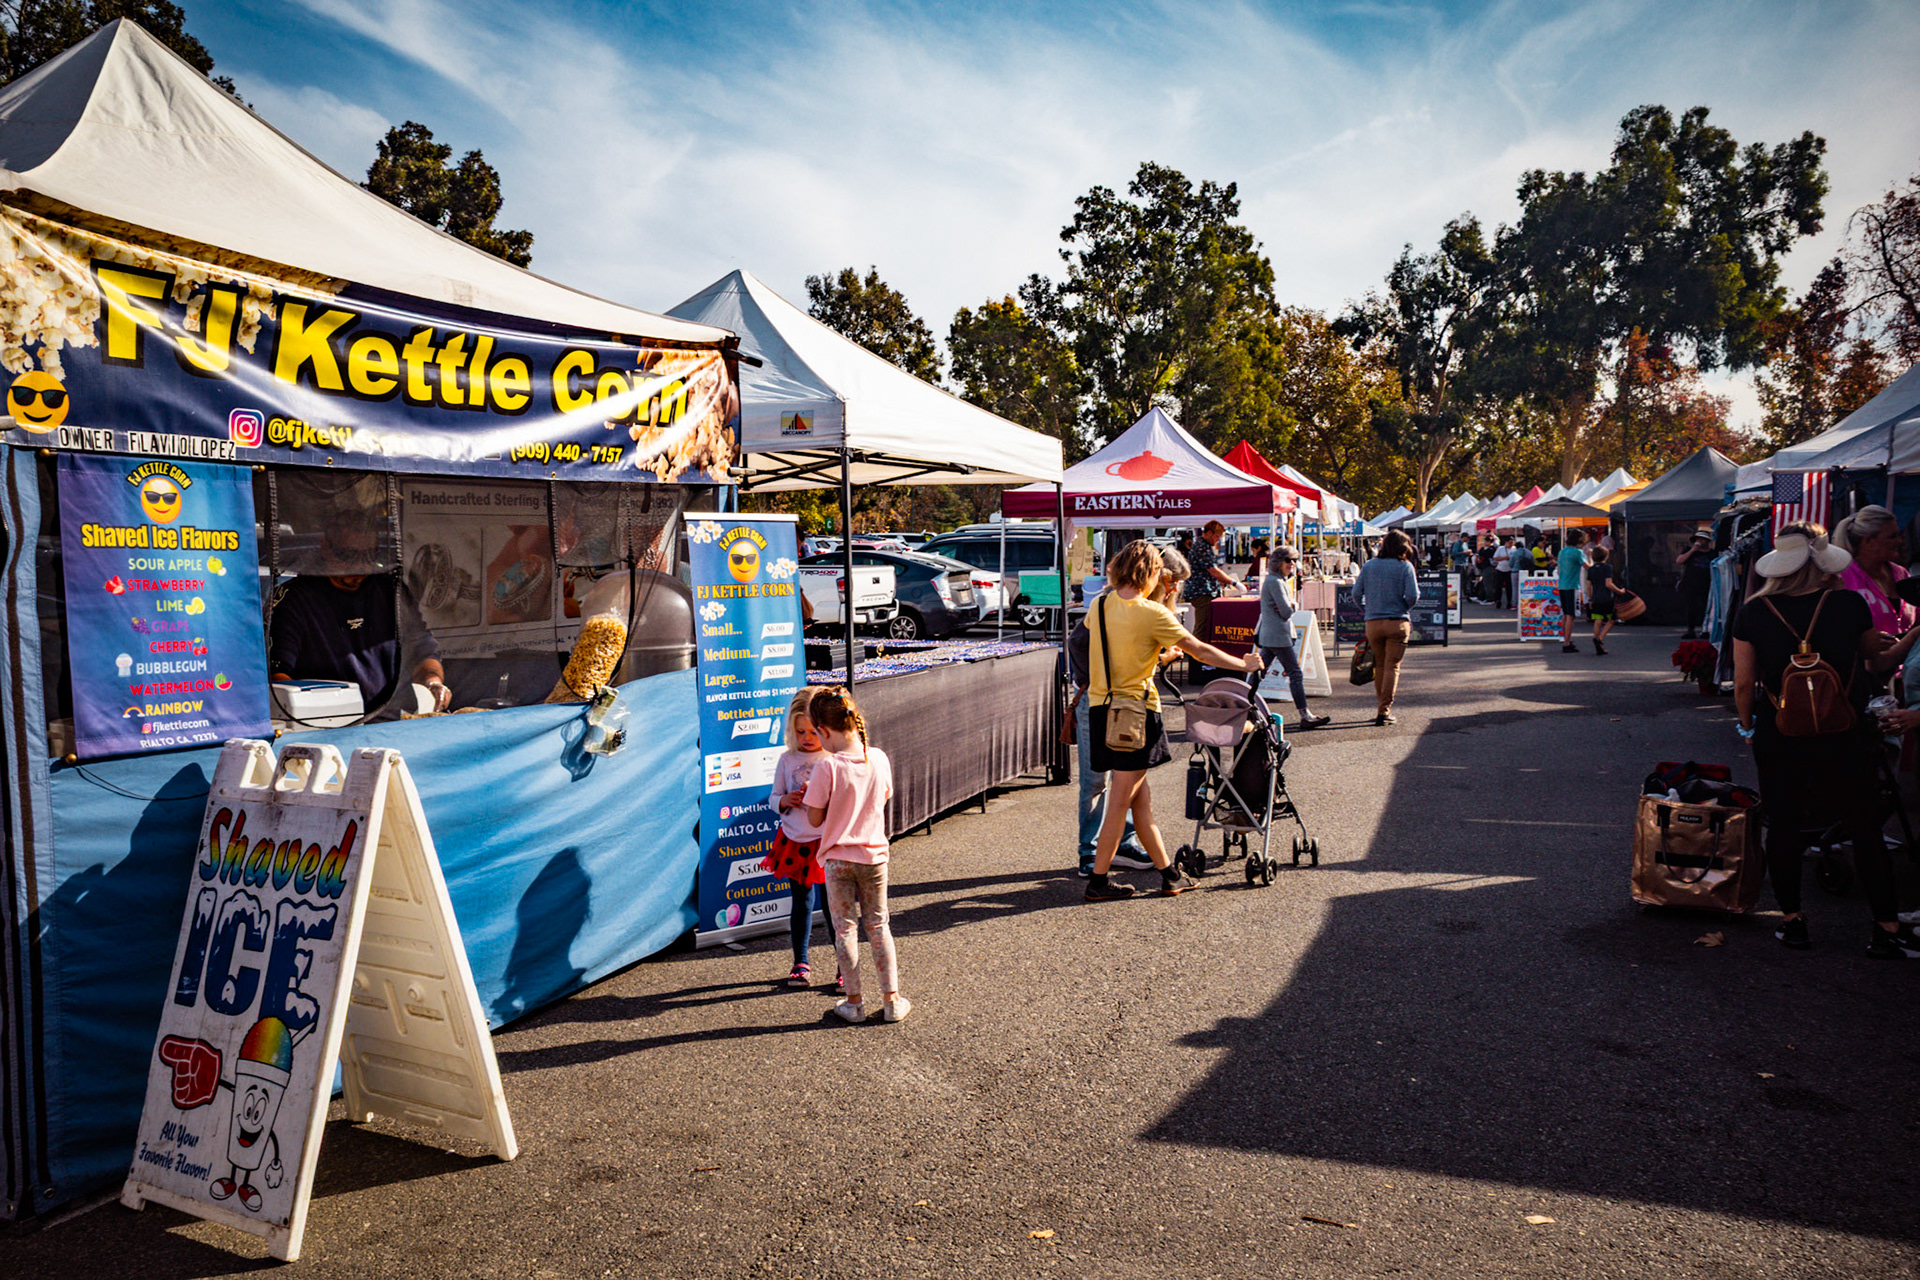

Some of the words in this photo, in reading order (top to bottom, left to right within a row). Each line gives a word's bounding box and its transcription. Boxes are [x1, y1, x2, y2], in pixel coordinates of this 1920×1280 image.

[93, 262, 243, 376] FJ
[272, 299, 534, 413] Kettle
[549, 347, 691, 426] Corn
[59, 427, 113, 450] OWNER
[510, 442, 551, 464] (909)
[553, 443, 580, 461] 440
[591, 445, 623, 463] 7157
[126, 470, 142, 486] FJ
[137, 461, 171, 478] KETTLE
[168, 465, 192, 489] CORN
[410, 490, 491, 506] Handcrafted
[494, 492, 540, 510] Sterling
[1074, 494, 1157, 511] EASTERN
[1156, 498, 1192, 509] TALES
[80, 523, 149, 548] Shaved
[151, 525, 178, 549] Ice
[180, 526, 239, 551] Flavors
[726, 526, 751, 543] KETTLE
[128, 557, 165, 571] SOUR
[168, 558, 203, 571] APPLE
[127, 578, 206, 592] STRAWBERRY
[697, 585, 709, 600] FJ
[711, 583, 760, 600] KETTLE
[761, 582, 796, 598] CORN
[156, 599, 184, 612] LIME
[151, 620, 190, 633] GRAPE
[1214, 625, 1256, 637] EASTERN
[149, 640, 194, 654] CHERRY
[136, 659, 208, 676] BUBBLEGUM
[129, 678, 214, 697] WATERMELON
[706, 692, 728, 703] FLAVOR
[728, 691, 752, 700] KETTLE
[752, 689, 771, 698] CORN
[779, 686, 798, 695] MORE
[145, 699, 204, 717] RAINBOW
[717, 707, 755, 721] Bottled
[756, 705, 786, 717] water
[152, 719, 210, 735] fjkettlecorn
[737, 722, 760, 732] $2.00
[140, 736, 175, 749] RIALTO
[193, 732, 218, 743] 92376
[725, 772, 741, 781] VISA
[718, 823, 754, 839] RIALTO
[756, 821, 772, 833] CA.
[199, 806, 358, 900] Shaved
[719, 840, 762, 858] Shaved
[765, 839, 775, 851] Ic
[726, 885, 765, 901] Cotton
[767, 881, 791, 893] Can
[750, 902, 778, 916] $5.00
[173, 886, 339, 1034] ICE
[159, 1120, 178, 1142] All
[176, 1123, 200, 1149] Your
[138, 1141, 175, 1170] Favorite
[174, 1153, 213, 1182] Flavors!
